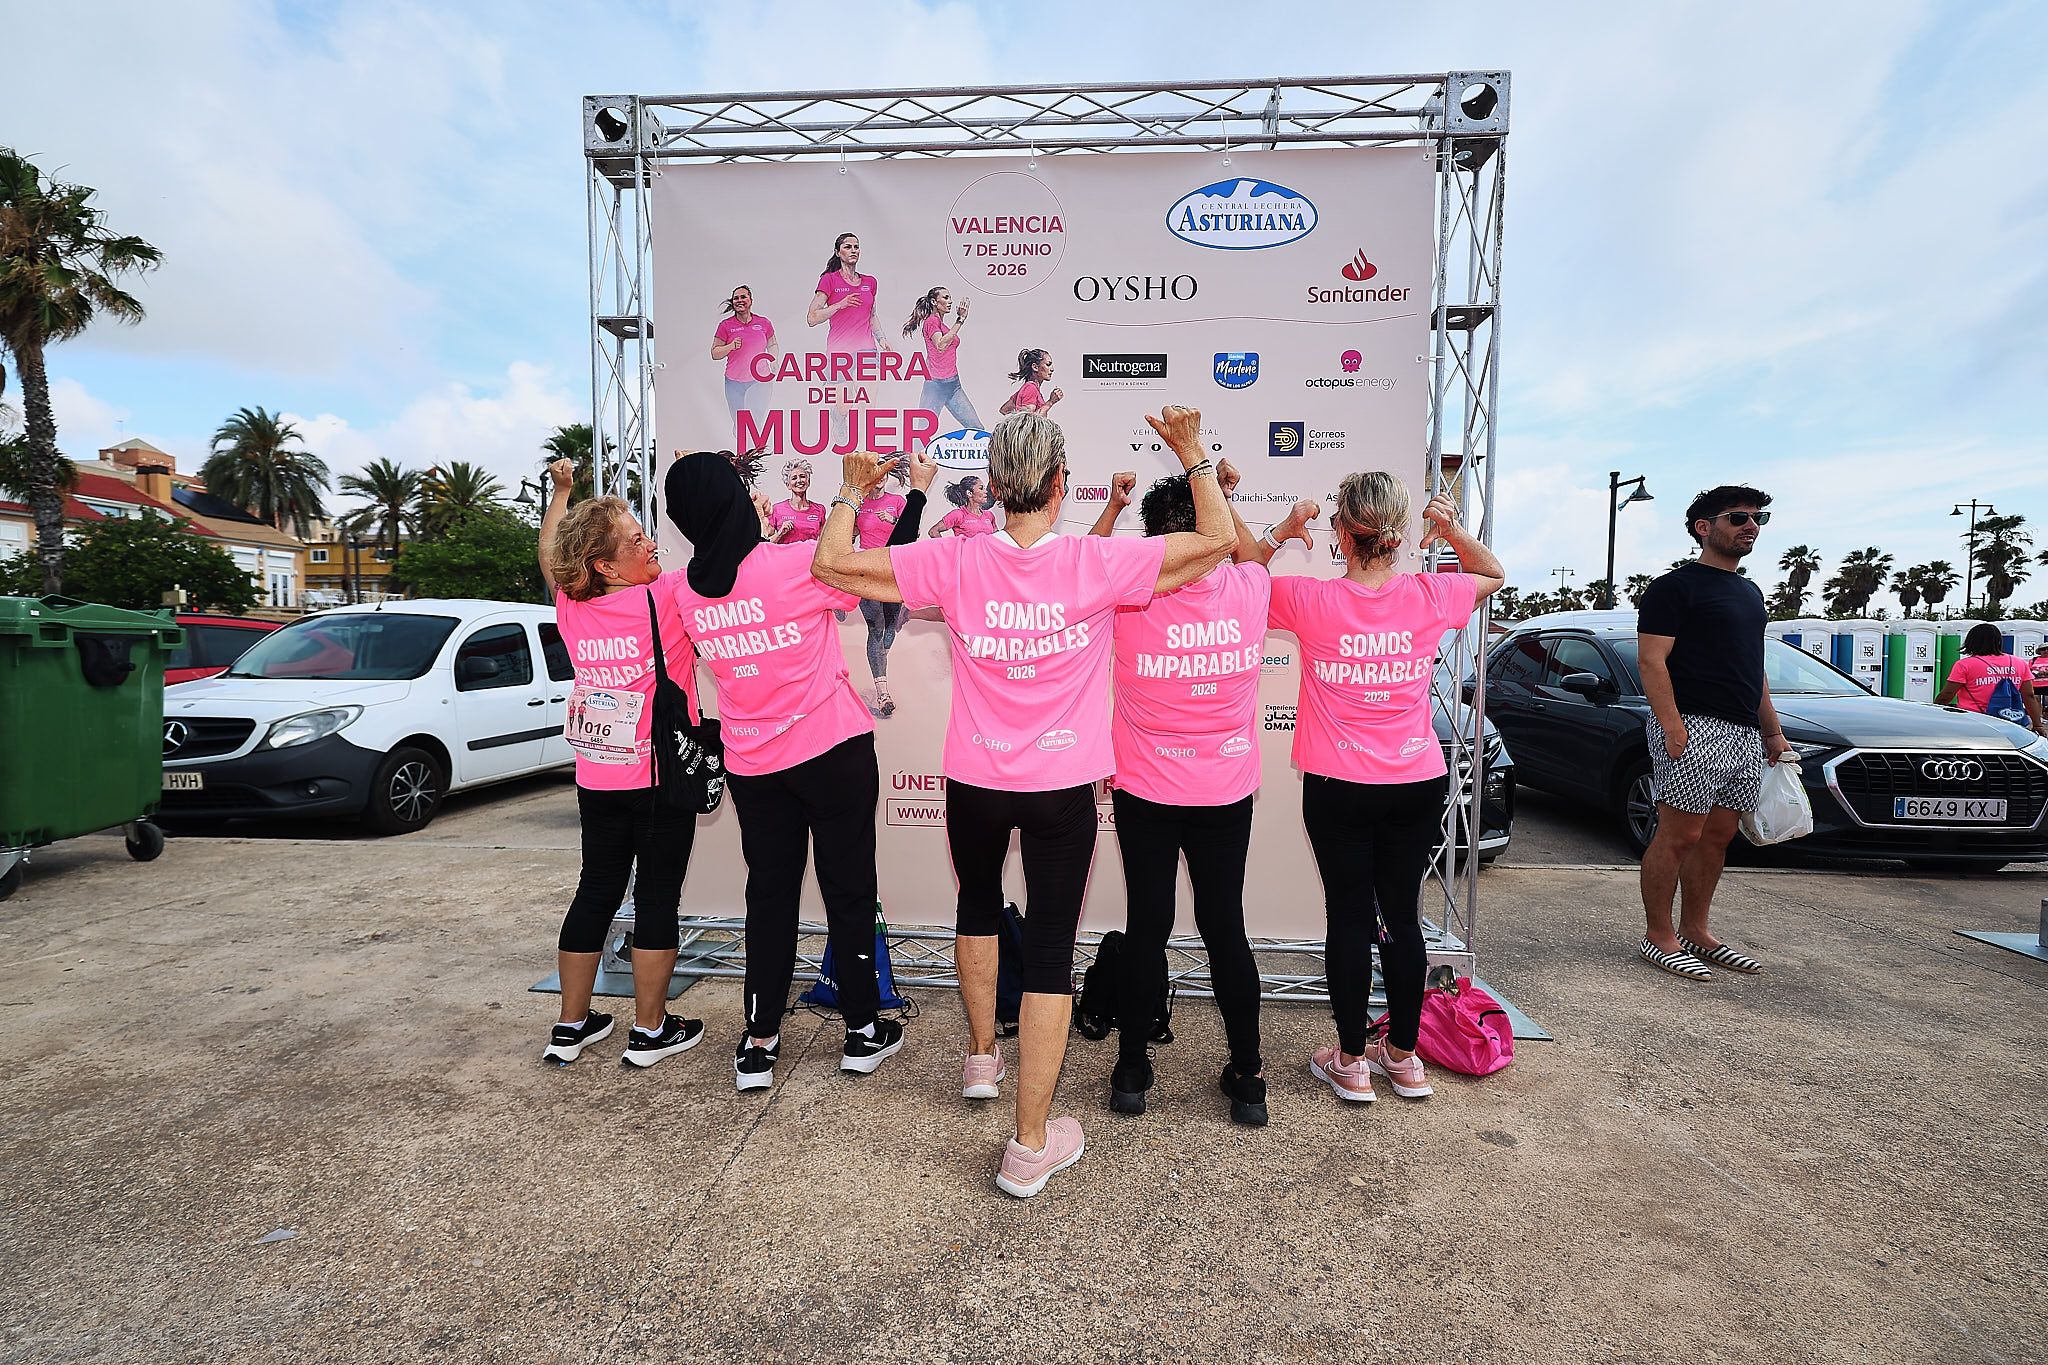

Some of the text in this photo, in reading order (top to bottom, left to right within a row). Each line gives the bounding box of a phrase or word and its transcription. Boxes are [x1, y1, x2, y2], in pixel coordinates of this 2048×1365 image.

[952, 216, 1064, 234] VALENCIA
[1178, 206, 1306, 232] ASTURIANA
[962, 243, 1052, 256] 7 DE JUNIO
[987, 263, 1028, 276] 2026
[1073, 274, 1198, 303] OYSHO
[1307, 285, 1410, 304] Santander
[750, 351, 932, 382] CARRERA
[1088, 358, 1162, 376] Neutrogena
[1216, 360, 1256, 380] Marlene
[808, 387, 870, 404] DE LA
[736, 408, 939, 456] MUJER
[1308, 430, 1345, 440] Correos
[932, 444, 988, 460] ASTURIA
[1130, 443, 1222, 452] VOO
[1309, 440, 1345, 450] Express
[1076, 487, 1108, 500] COSMO
[1231, 492, 1298, 506] Daiichi-Sankyo
[694, 598, 766, 634] SOMOS
[985, 600, 1066, 630] SOMOS
[695, 622, 802, 662] MPARABLES
[1166, 618, 1242, 649] SOMOS
[577, 636, 640, 662] SOMOS
[1339, 631, 1412, 657] SOMOS
[1136, 643, 1260, 679] IMPARABLES
[733, 664, 759, 678] 2026
[1007, 664, 1036, 679] 2026
[1312, 655, 1432, 685] IMPARABLES
[1191, 682, 1217, 696] 2026
[1364, 690, 1390, 702] 2026
[584, 722, 612, 736] 016
[729, 727, 760, 736] YSHO
[972, 733, 1011, 752] OSHO
[1155, 746, 1196, 758] OYSHO
[169, 774, 198, 788] HVH
[892, 770, 946, 790] ÚNET
[1907, 800, 1958, 816] 6649
[1965, 801, 2000, 817] KXJ
[819, 973, 830, 985] ILD
